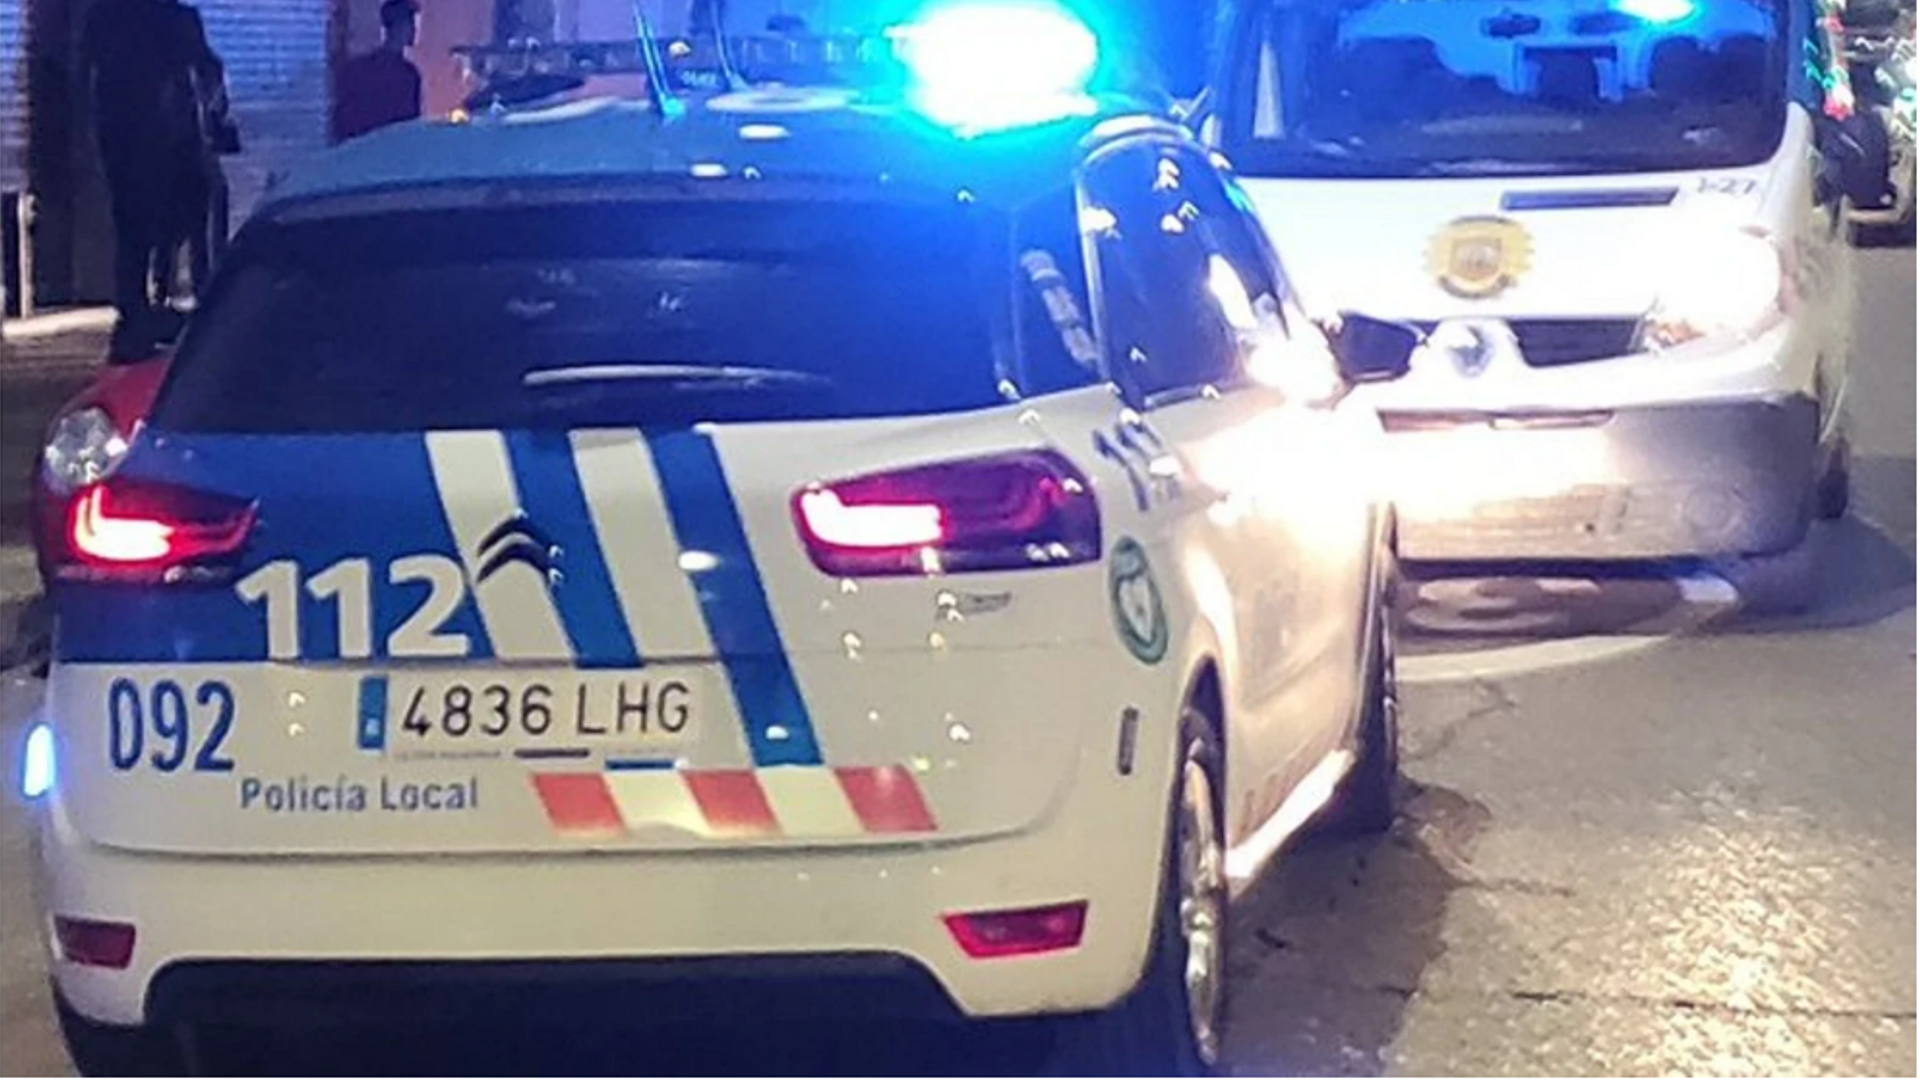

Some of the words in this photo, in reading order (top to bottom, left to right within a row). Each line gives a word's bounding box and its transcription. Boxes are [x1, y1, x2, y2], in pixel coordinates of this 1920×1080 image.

[235, 553, 471, 659] 112
[108, 677, 235, 772] 092
[401, 684, 553, 737] 4836
[576, 681, 690, 735] LHG
[240, 773, 366, 812] Policía
[380, 774, 478, 811] Local
